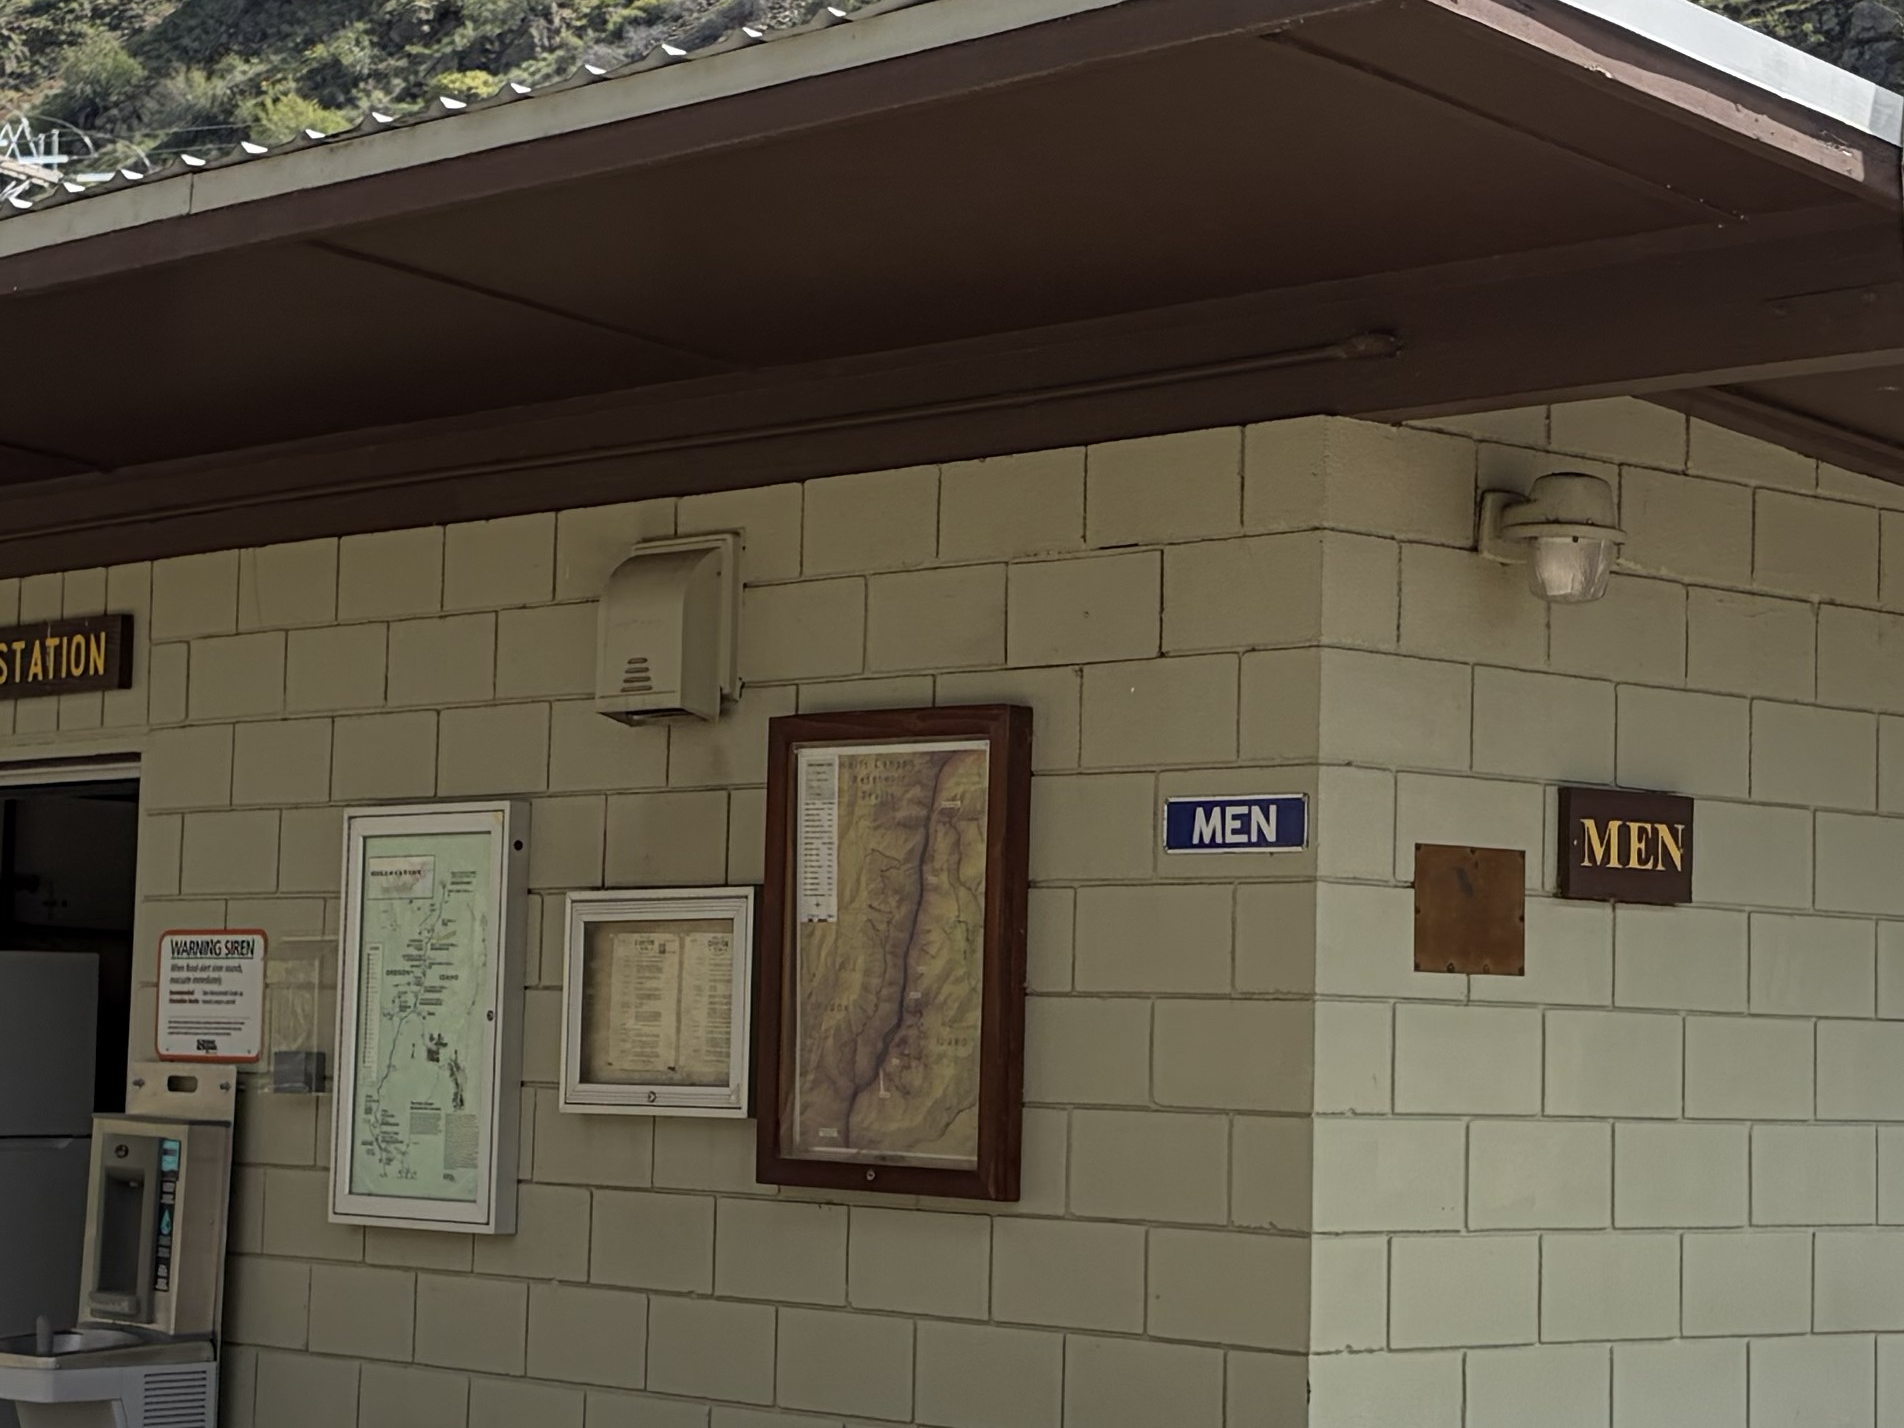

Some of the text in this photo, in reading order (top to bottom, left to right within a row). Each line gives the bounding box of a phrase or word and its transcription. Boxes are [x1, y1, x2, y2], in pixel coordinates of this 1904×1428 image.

[1192, 804, 1278, 845] MEN
[1580, 818, 1686, 872] MEN
[170, 938, 255, 957] WARNING SIREN
